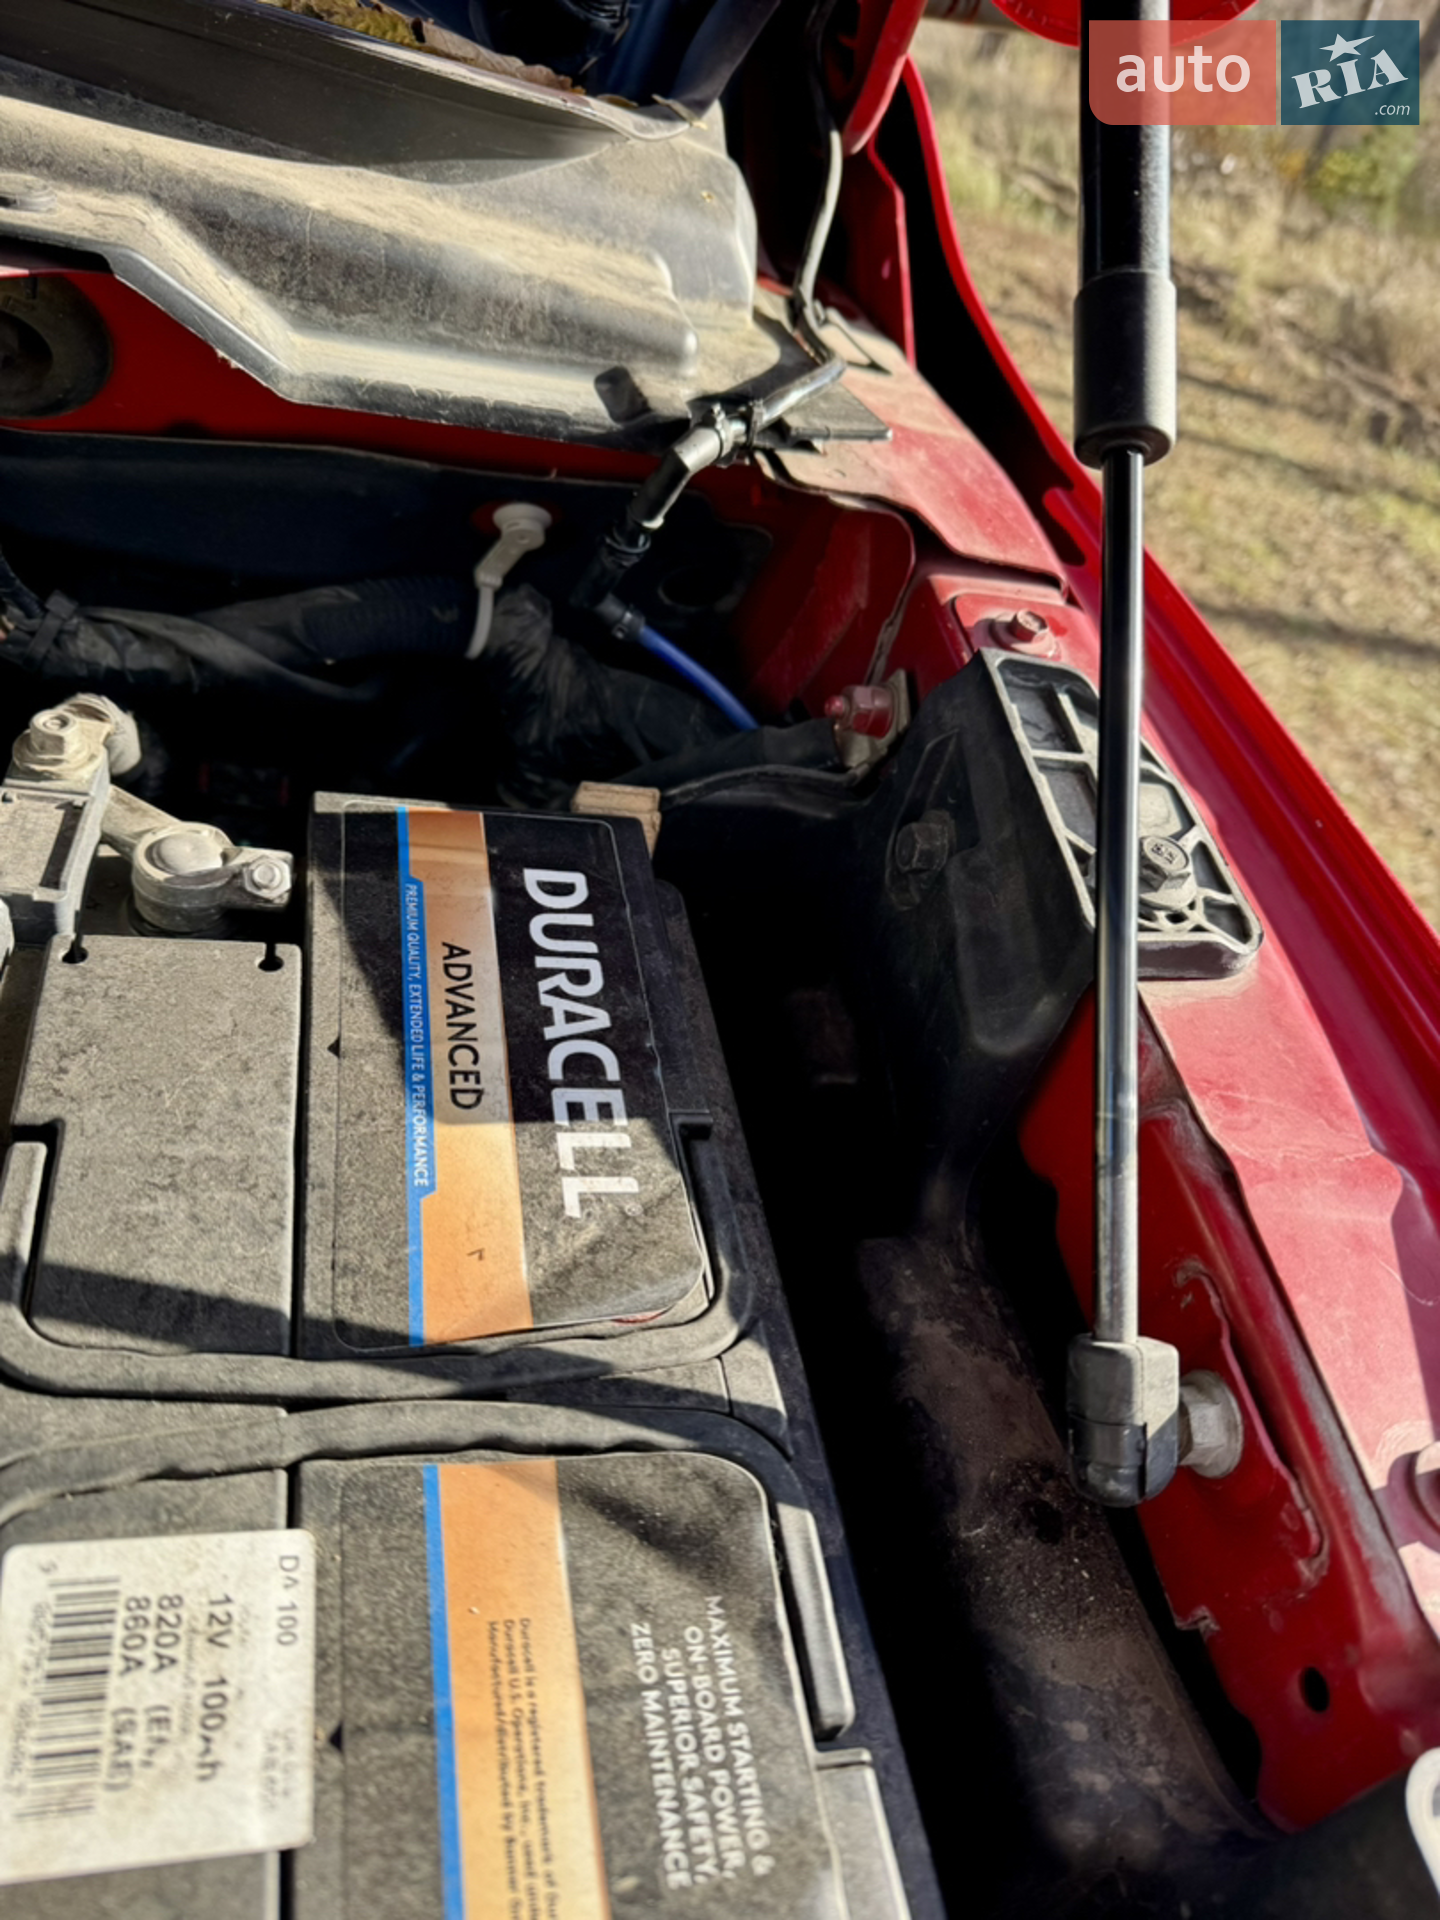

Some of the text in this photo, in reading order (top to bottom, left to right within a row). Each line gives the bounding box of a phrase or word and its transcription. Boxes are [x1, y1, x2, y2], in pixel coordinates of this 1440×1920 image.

[405, 883, 429, 1187] PREMIUM QUALITY, EXTENDED LIFE & PERFORMANCE
[442, 942, 484, 1110] ADVANCED
[523, 868, 640, 1219] DURACELL
[118, 1596, 151, 1677] 860A
[150, 1594, 183, 1674] 820A
[206, 1593, 234, 1650] 12V
[275, 1601, 299, 1647] 100
[503, 1618, 520, 1675] Duracell
[520, 1617, 536, 1674] Duracell
[527, 1702, 546, 1776] registered
[630, 1622, 693, 1889] ZERO MAINTENANCE
[661, 1648, 721, 1884] SUPERIOR SAFETY,
[684, 1626, 746, 1879] ON-BOARD POWER,
[705, 1595, 776, 1877] MAXIMUM STARTING &
